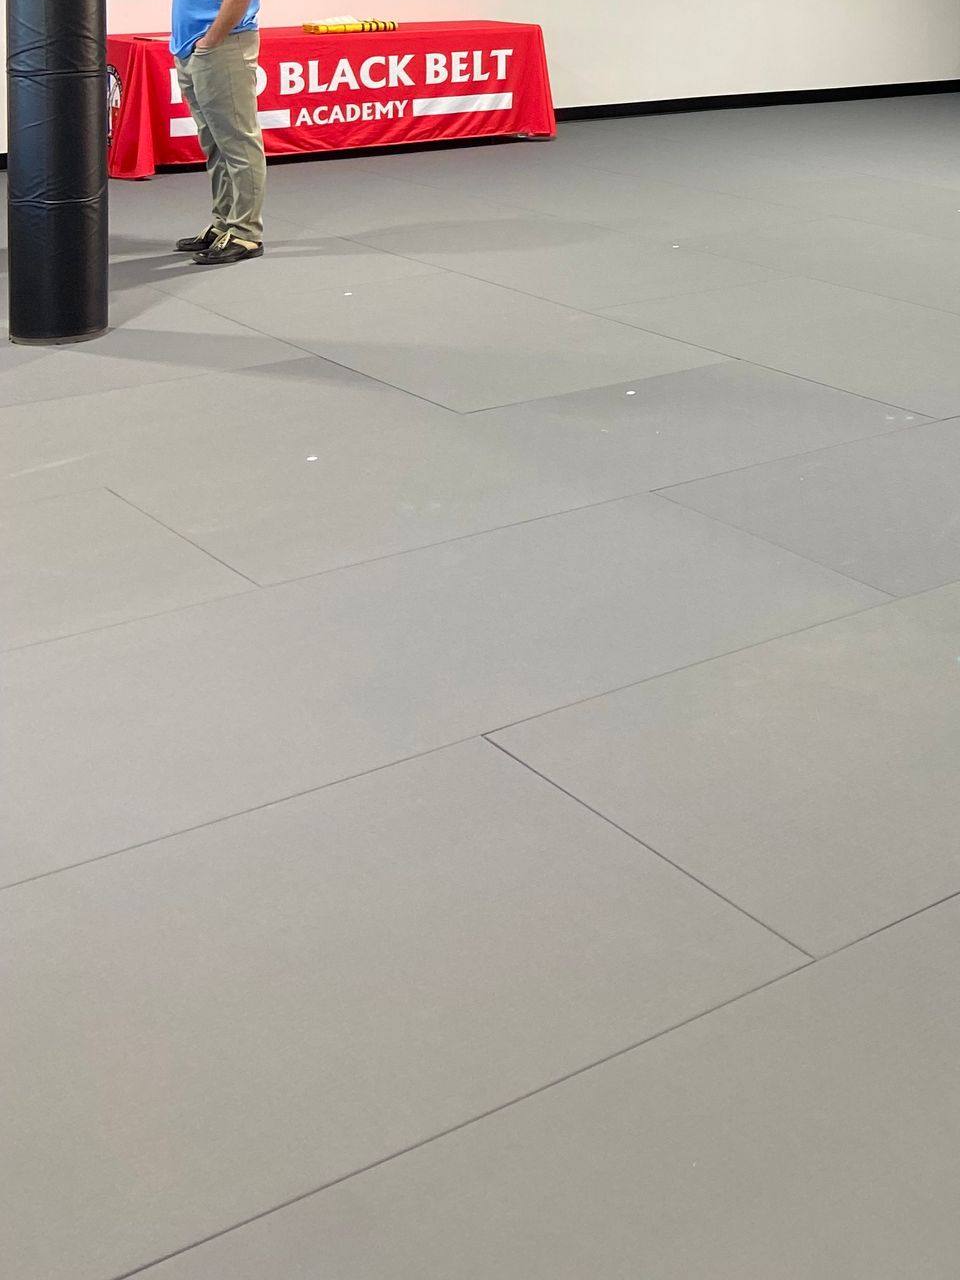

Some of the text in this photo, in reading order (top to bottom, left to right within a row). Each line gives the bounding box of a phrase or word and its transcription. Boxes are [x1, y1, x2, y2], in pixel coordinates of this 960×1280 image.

[279, 54, 415, 95] BLACK
[425, 49, 514, 85] BELT
[295, 99, 408, 127] ACADEMY
